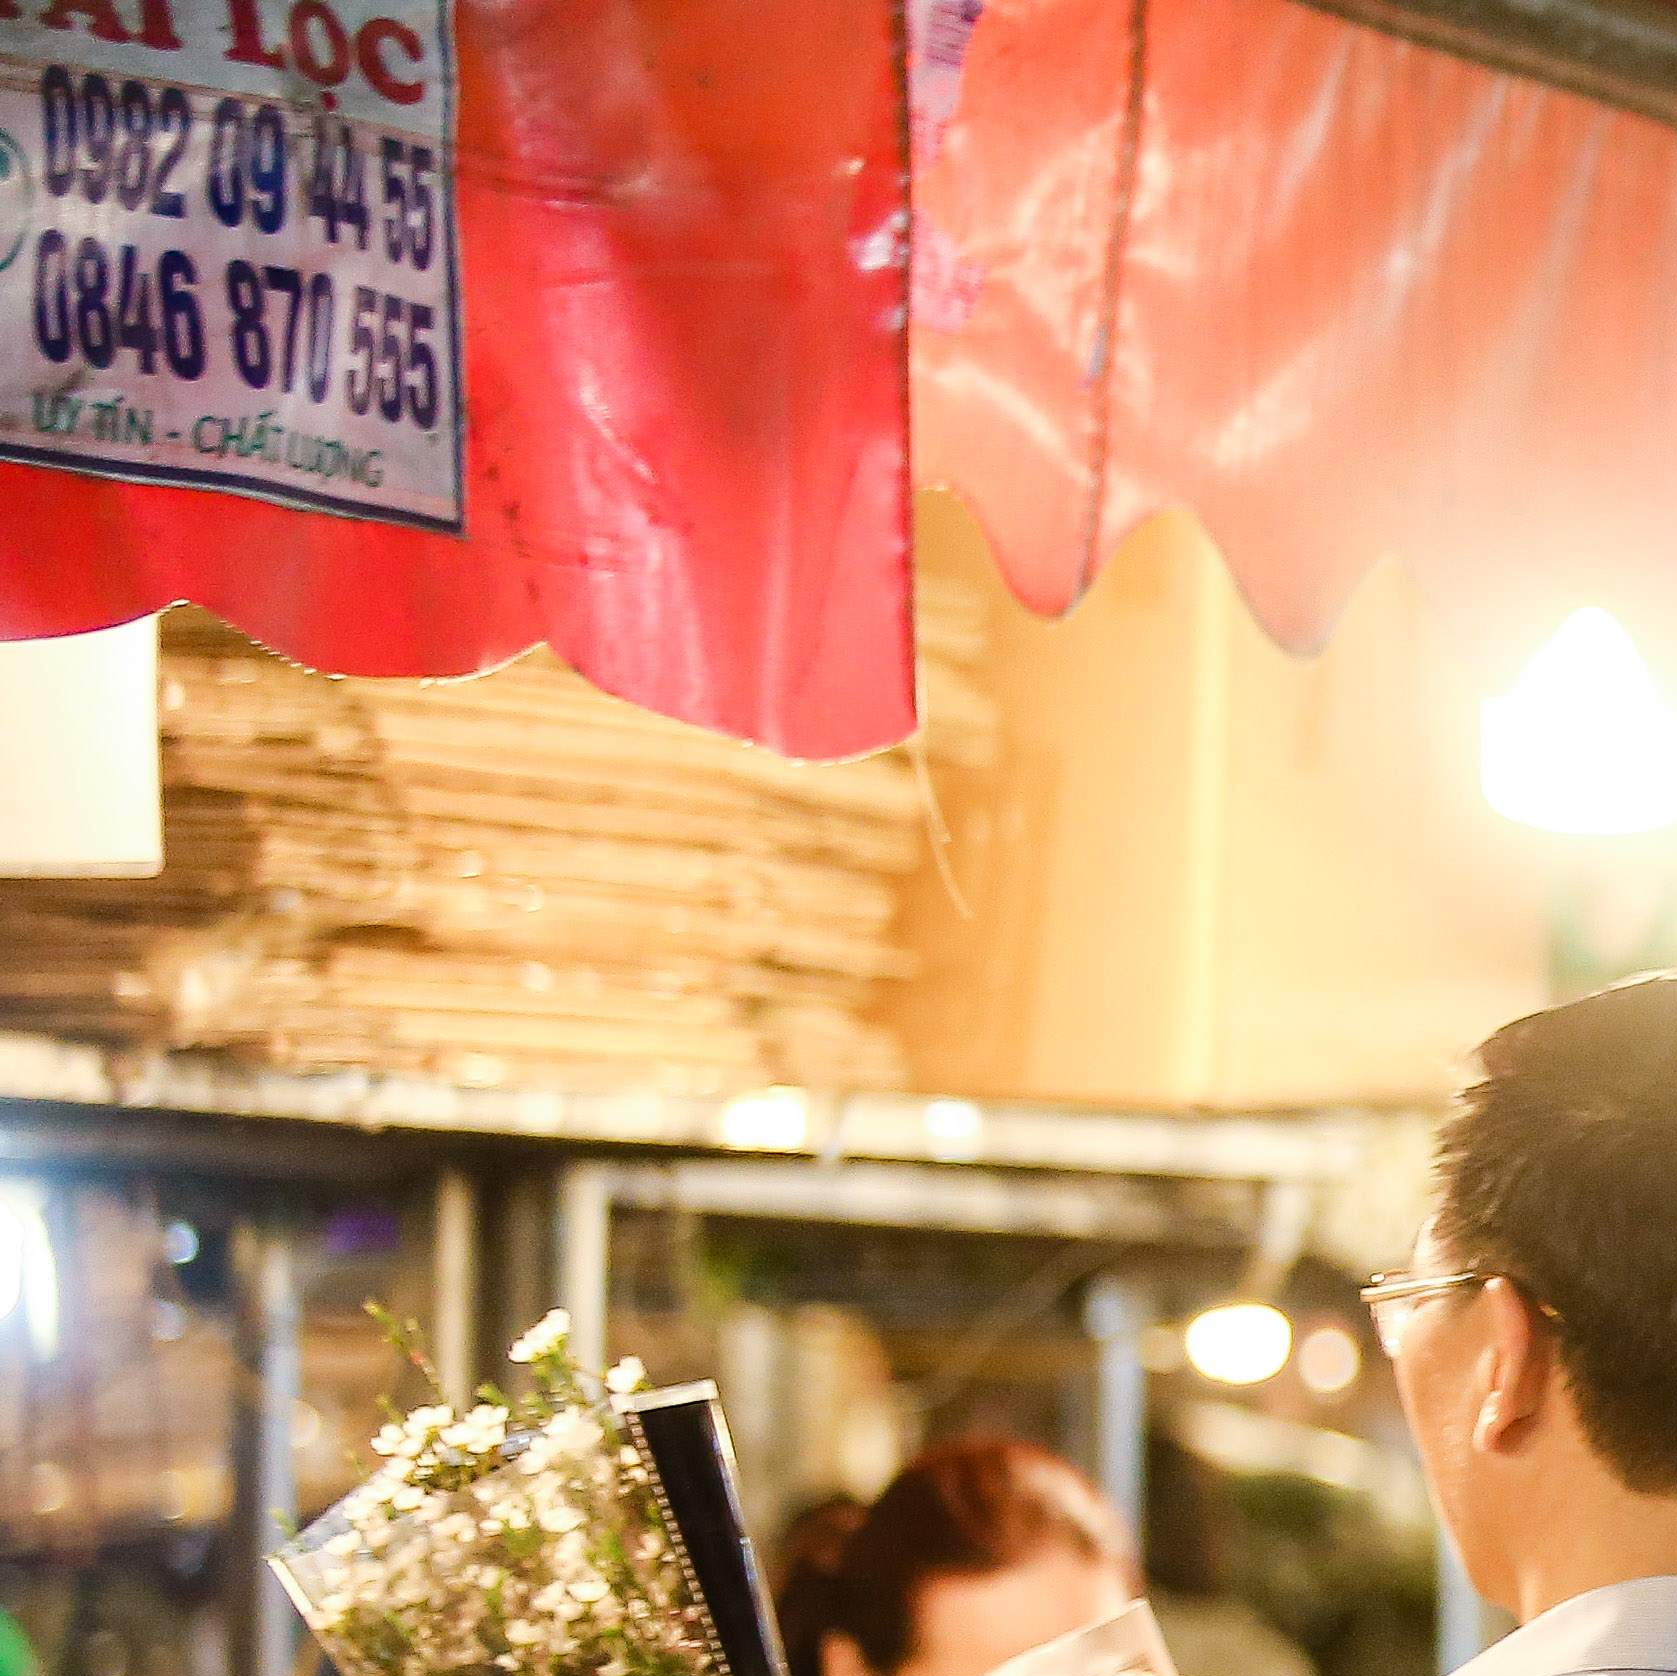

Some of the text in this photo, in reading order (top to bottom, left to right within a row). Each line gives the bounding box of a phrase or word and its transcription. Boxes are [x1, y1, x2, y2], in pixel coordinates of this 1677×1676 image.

[42, 65, 190, 217] 0982
[210, 98, 286, 235] 09
[381, 137, 436, 271] 55
[36, 229, 440, 430] 0846 870 555
